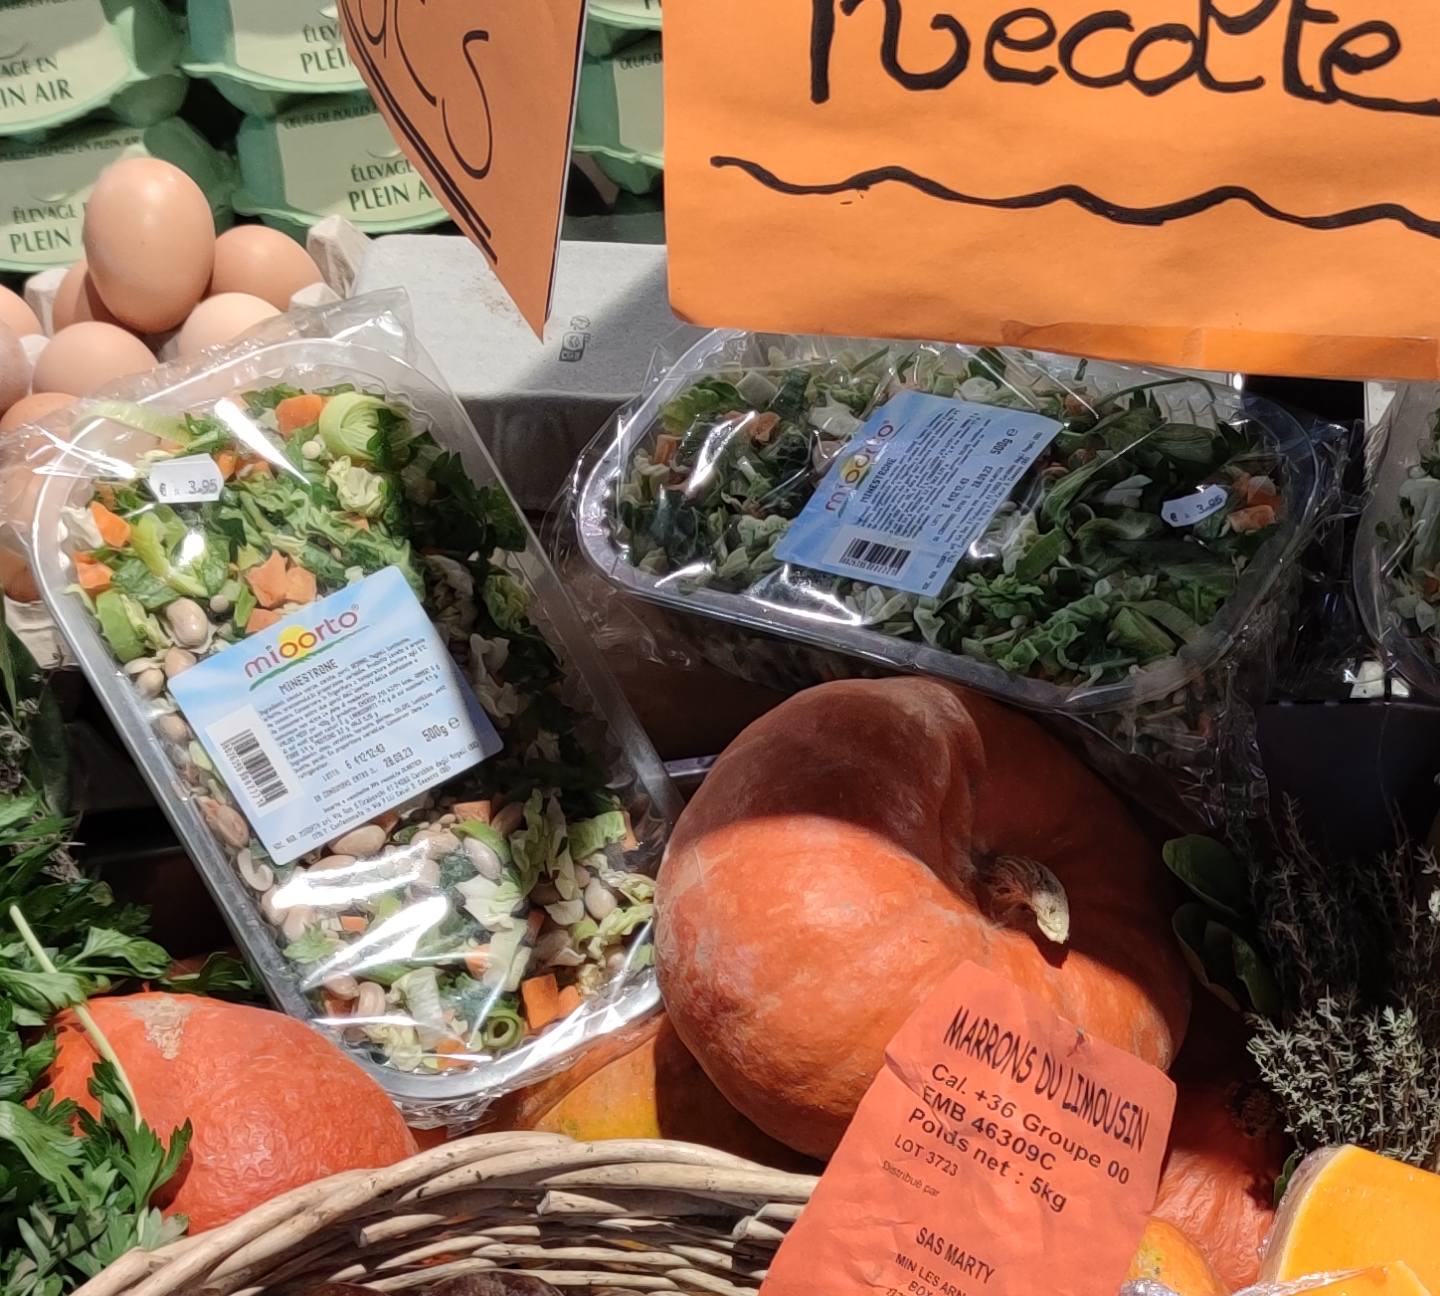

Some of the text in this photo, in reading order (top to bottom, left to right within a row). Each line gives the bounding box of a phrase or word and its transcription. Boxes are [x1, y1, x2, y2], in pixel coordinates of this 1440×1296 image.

[36, 56, 59, 71] EN
[35, 79, 73, 103] AIR
[13, 204, 78, 225] ÉLEVAGE
[348, 182, 410, 212] PLEIN
[10, 227, 72, 254] PLEIN
[989, 437, 1013, 455] 500g
[859, 457, 896, 502] MINESTRONE
[244, 611, 357, 677] mioorto
[278, 658, 338, 694] MINESTRONE
[420, 724, 449, 742] 500g
[943, 1007, 1149, 1150] MARRONS DU LIMOUSIN
[922, 1085, 1055, 1170] EMB 46309C
[931, 1063, 967, 1094] Cal.
[974, 1089, 1016, 1118] +36
[1022, 1113, 1101, 1167] Groupe
[894, 1133, 958, 1176] LOT 3723
[908, 1107, 968, 1152] Poids
[972, 1147, 1010, 1176] net
[1029, 1176, 1066, 1212] 5kg
[894, 1252, 917, 1273] MIN
[917, 1265, 940, 1286] LES
[915, 1226, 994, 1283] SAS MARTY
